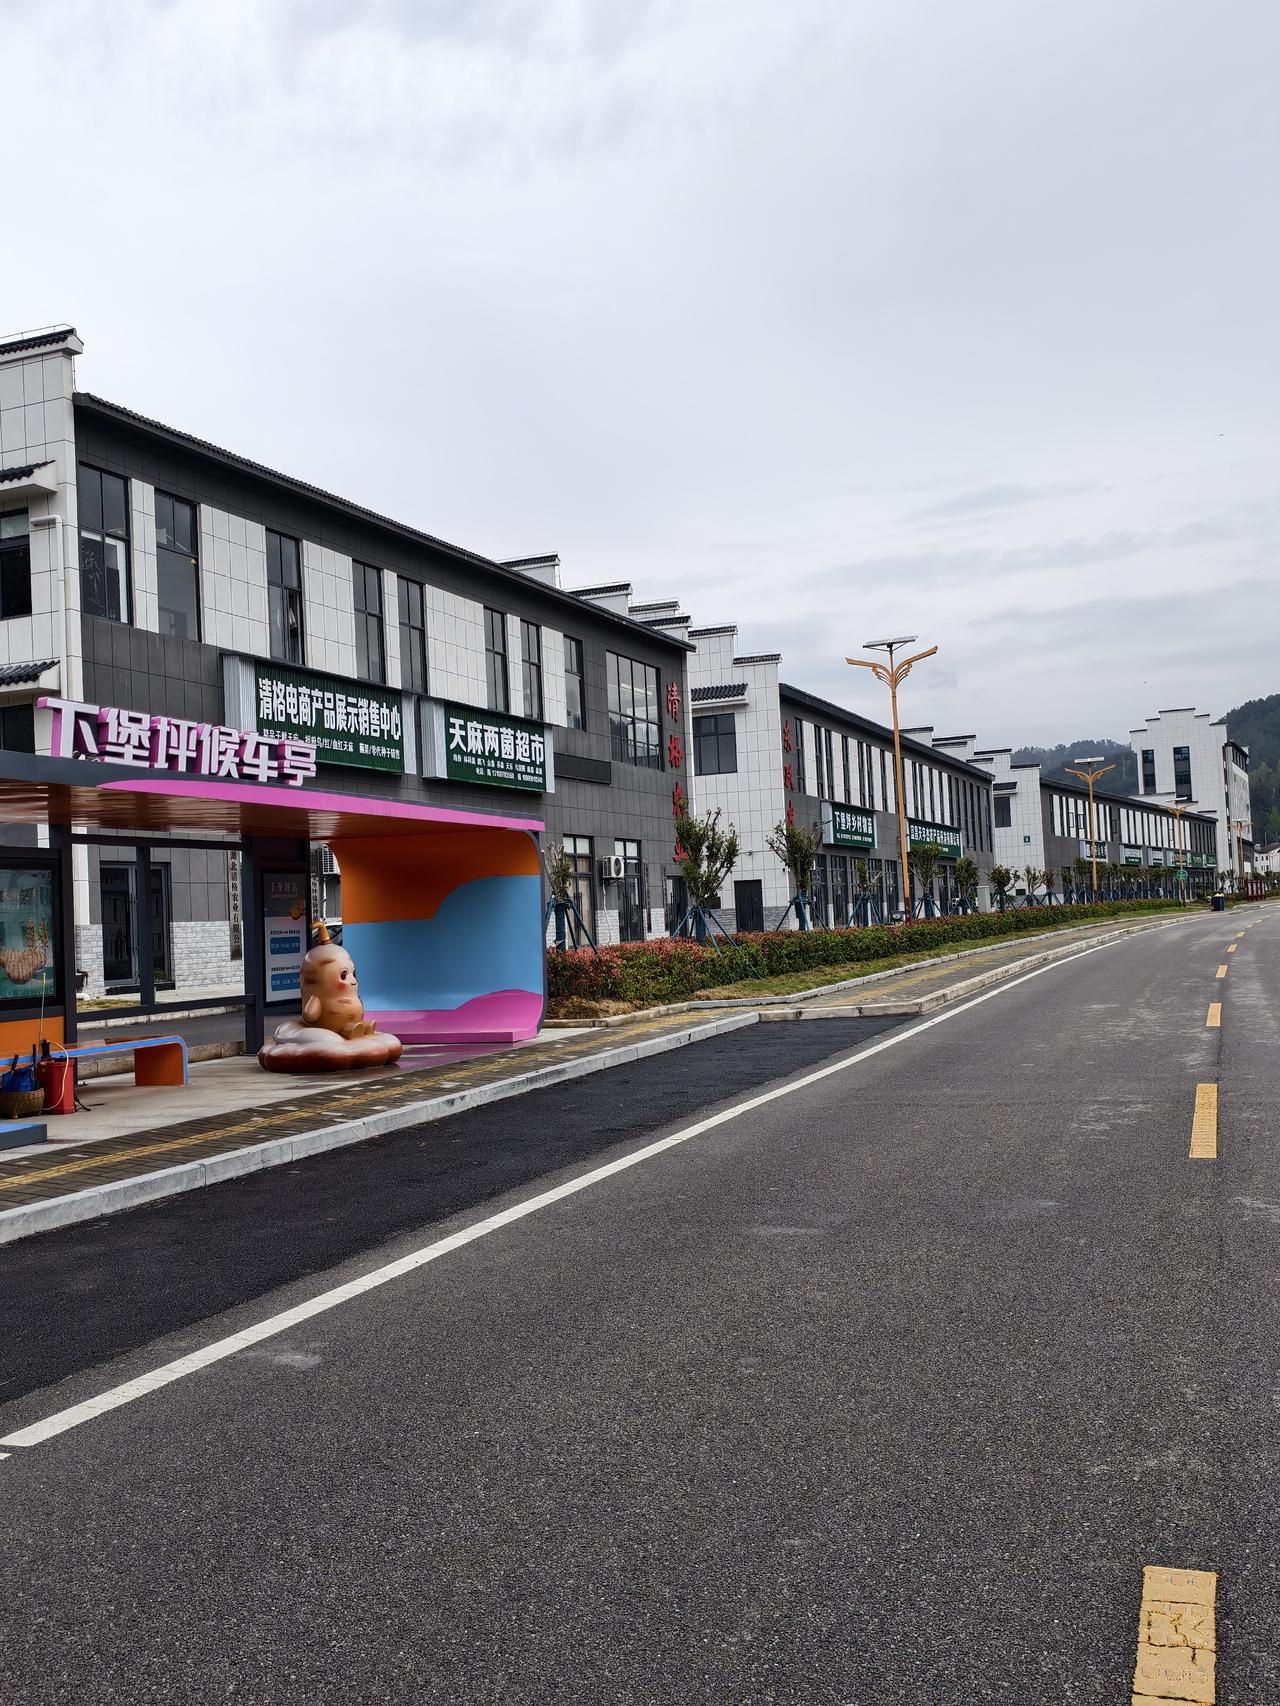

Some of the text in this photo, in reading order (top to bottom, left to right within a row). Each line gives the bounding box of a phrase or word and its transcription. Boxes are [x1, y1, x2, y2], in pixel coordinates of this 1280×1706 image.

[258, 678, 401, 740] 清格电商产品展示销售中心
[38, 696, 317, 787] 下堡坪候车亭
[449, 717, 544, 765] 天麻两菌超市
